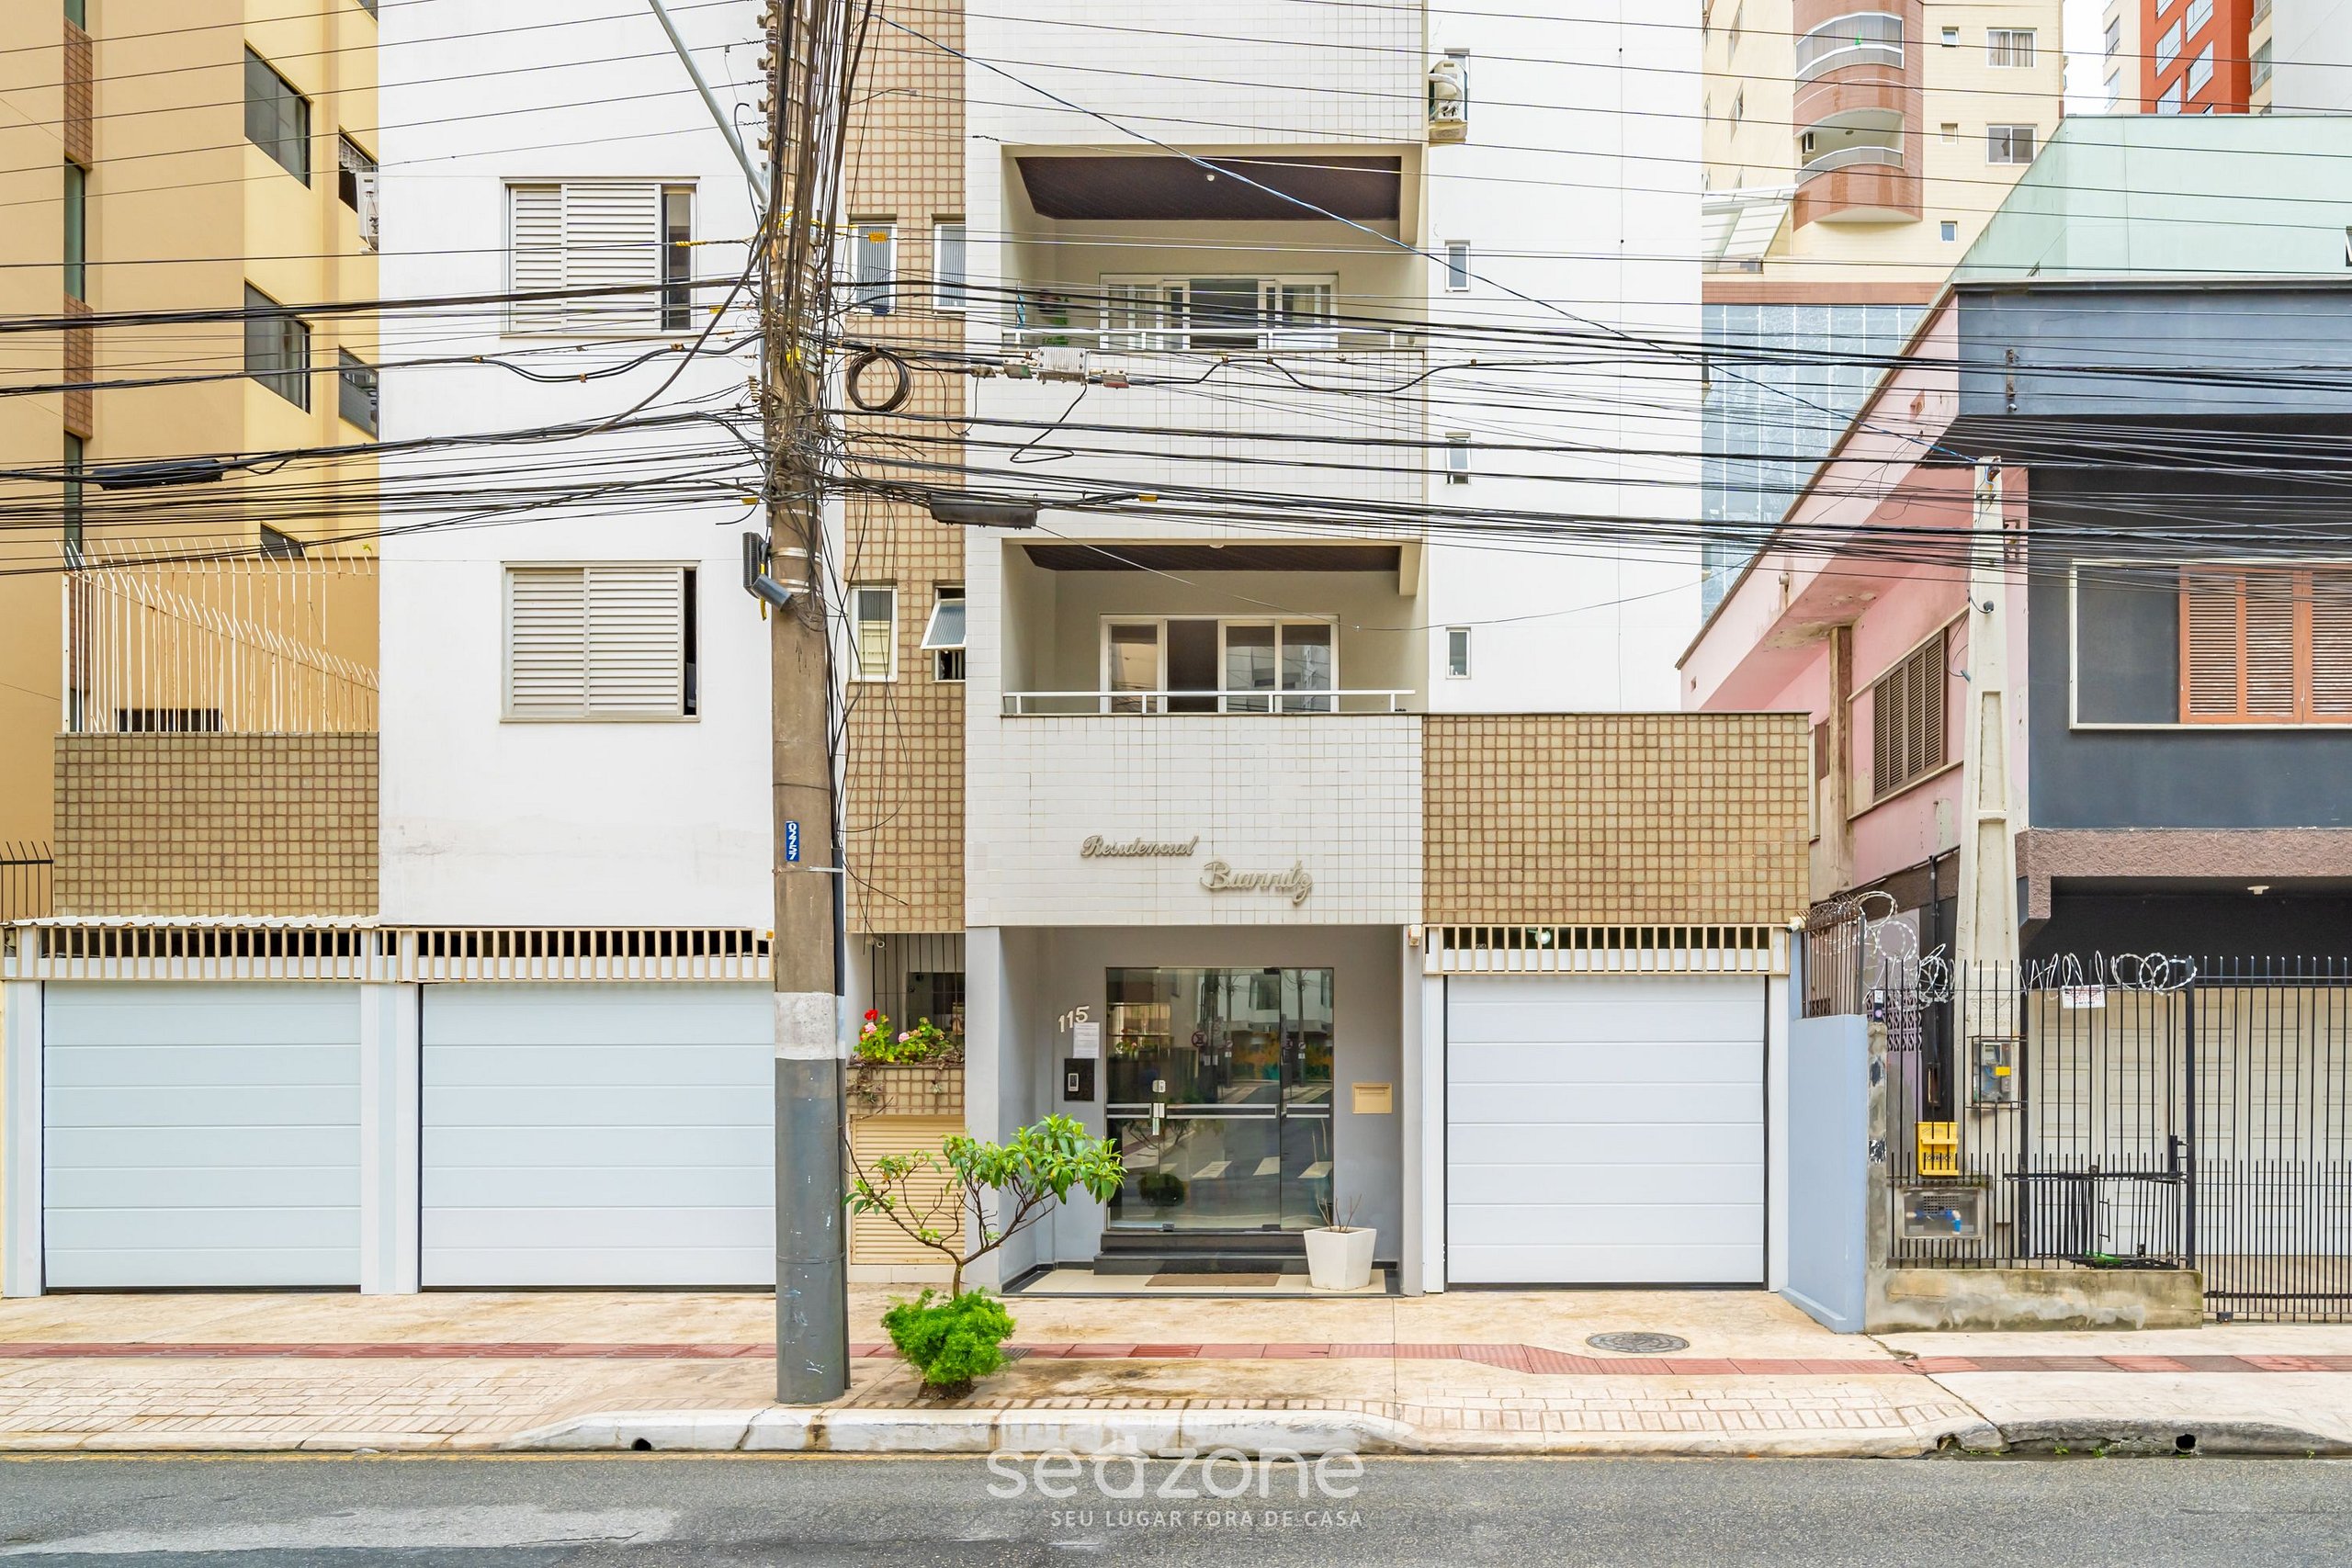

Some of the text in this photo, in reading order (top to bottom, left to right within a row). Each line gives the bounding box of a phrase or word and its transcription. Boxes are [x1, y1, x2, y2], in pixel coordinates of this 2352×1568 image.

[1080, 835, 1200, 858] Residencial
[1199, 860, 1314, 905] Biarritz
[1058, 1006, 1090, 1032] 115
